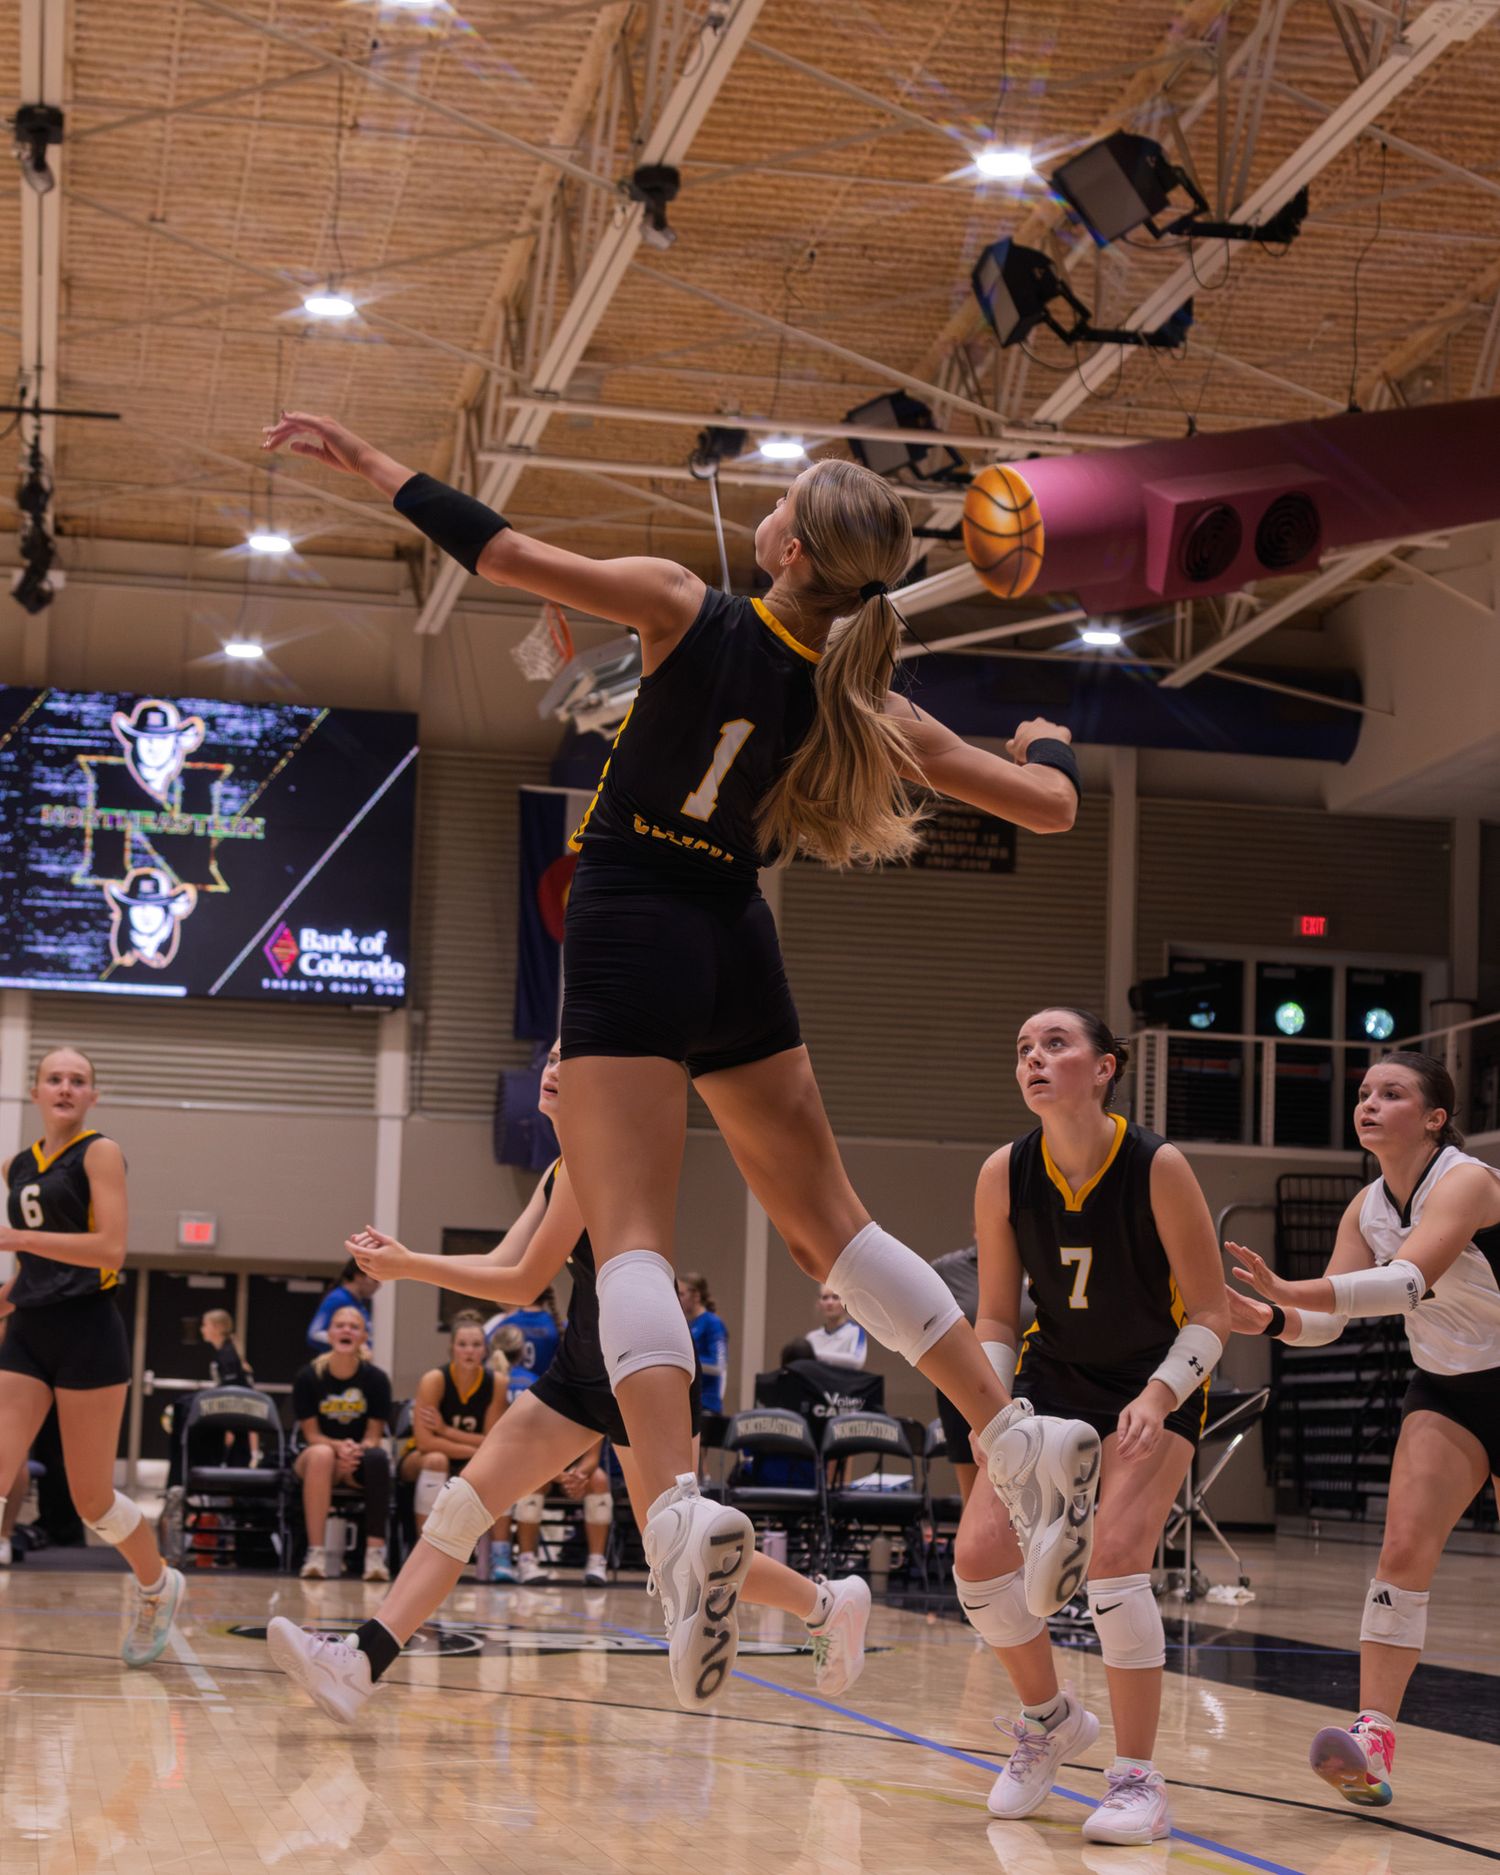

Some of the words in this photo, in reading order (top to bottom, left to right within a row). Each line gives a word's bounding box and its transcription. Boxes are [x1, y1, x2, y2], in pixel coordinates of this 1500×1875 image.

[680, 718, 755, 822] 1
[300, 928, 357, 954] Bank
[359, 930, 388, 956] of
[1301, 915, 1326, 936] EXIT
[299, 952, 406, 981] Colorado
[20, 1184, 44, 1228] 6
[1059, 1246, 1093, 1309] 7
